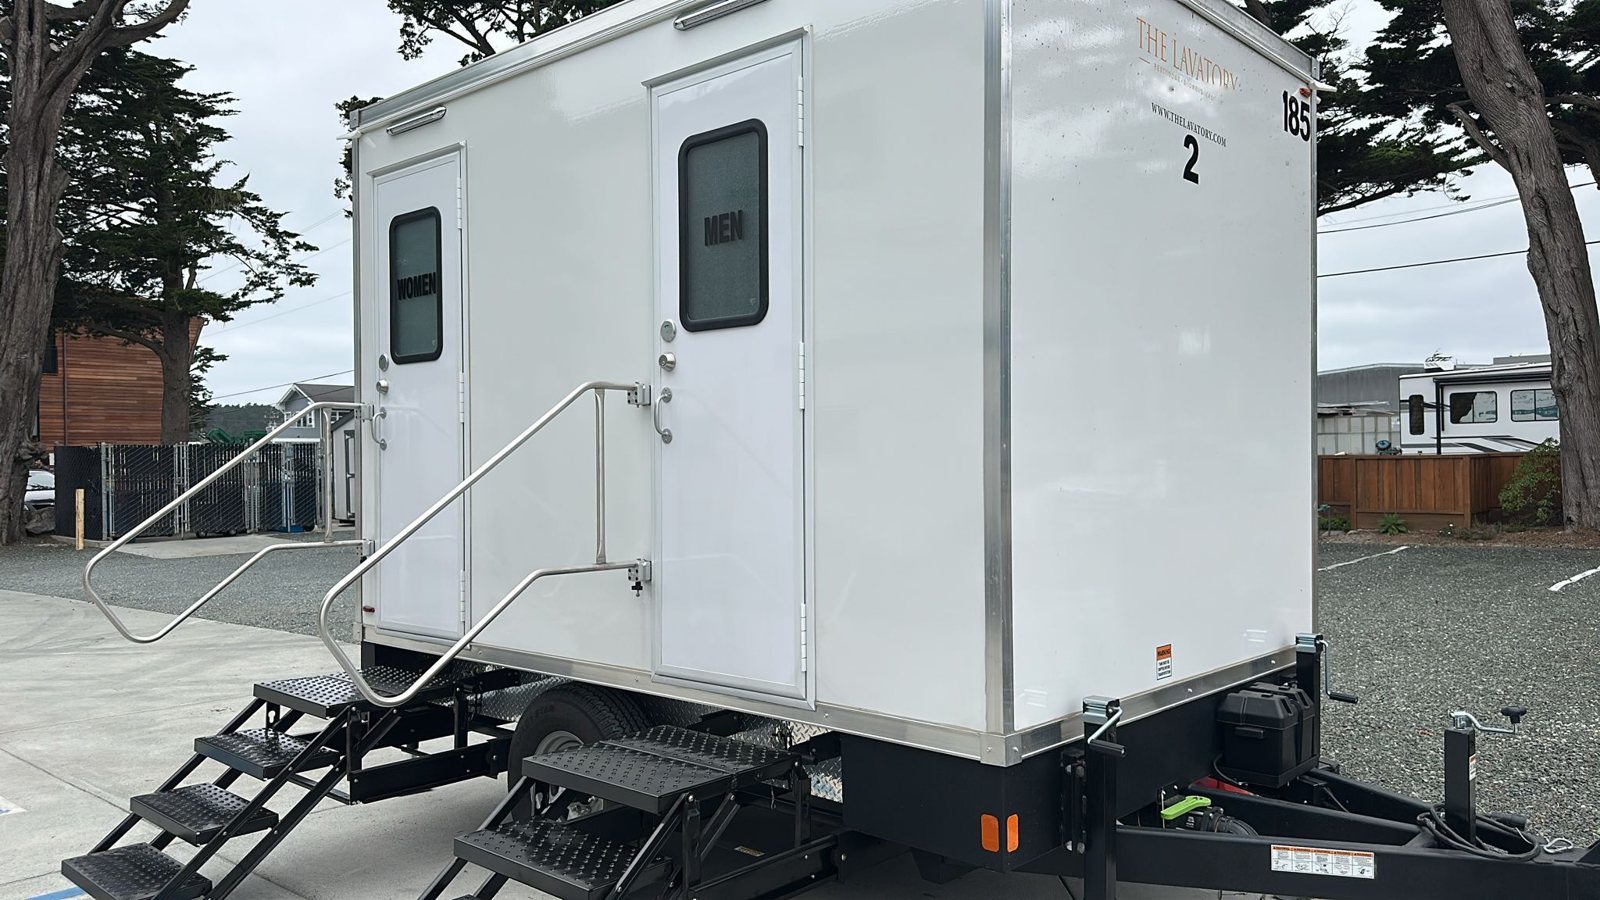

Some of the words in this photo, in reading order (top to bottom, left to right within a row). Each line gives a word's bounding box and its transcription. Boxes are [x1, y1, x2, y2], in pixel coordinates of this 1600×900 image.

[1136, 17, 1167, 63] THE
[1173, 40, 1238, 90] LAVATORY
[1151, 102, 1227, 147] WWW.THELAVATORY.COM
[1282, 90, 1310, 142] 185
[1183, 134, 1199, 184] 2
[704, 210, 743, 247] MEN
[397, 271, 437, 301] WOMEN
